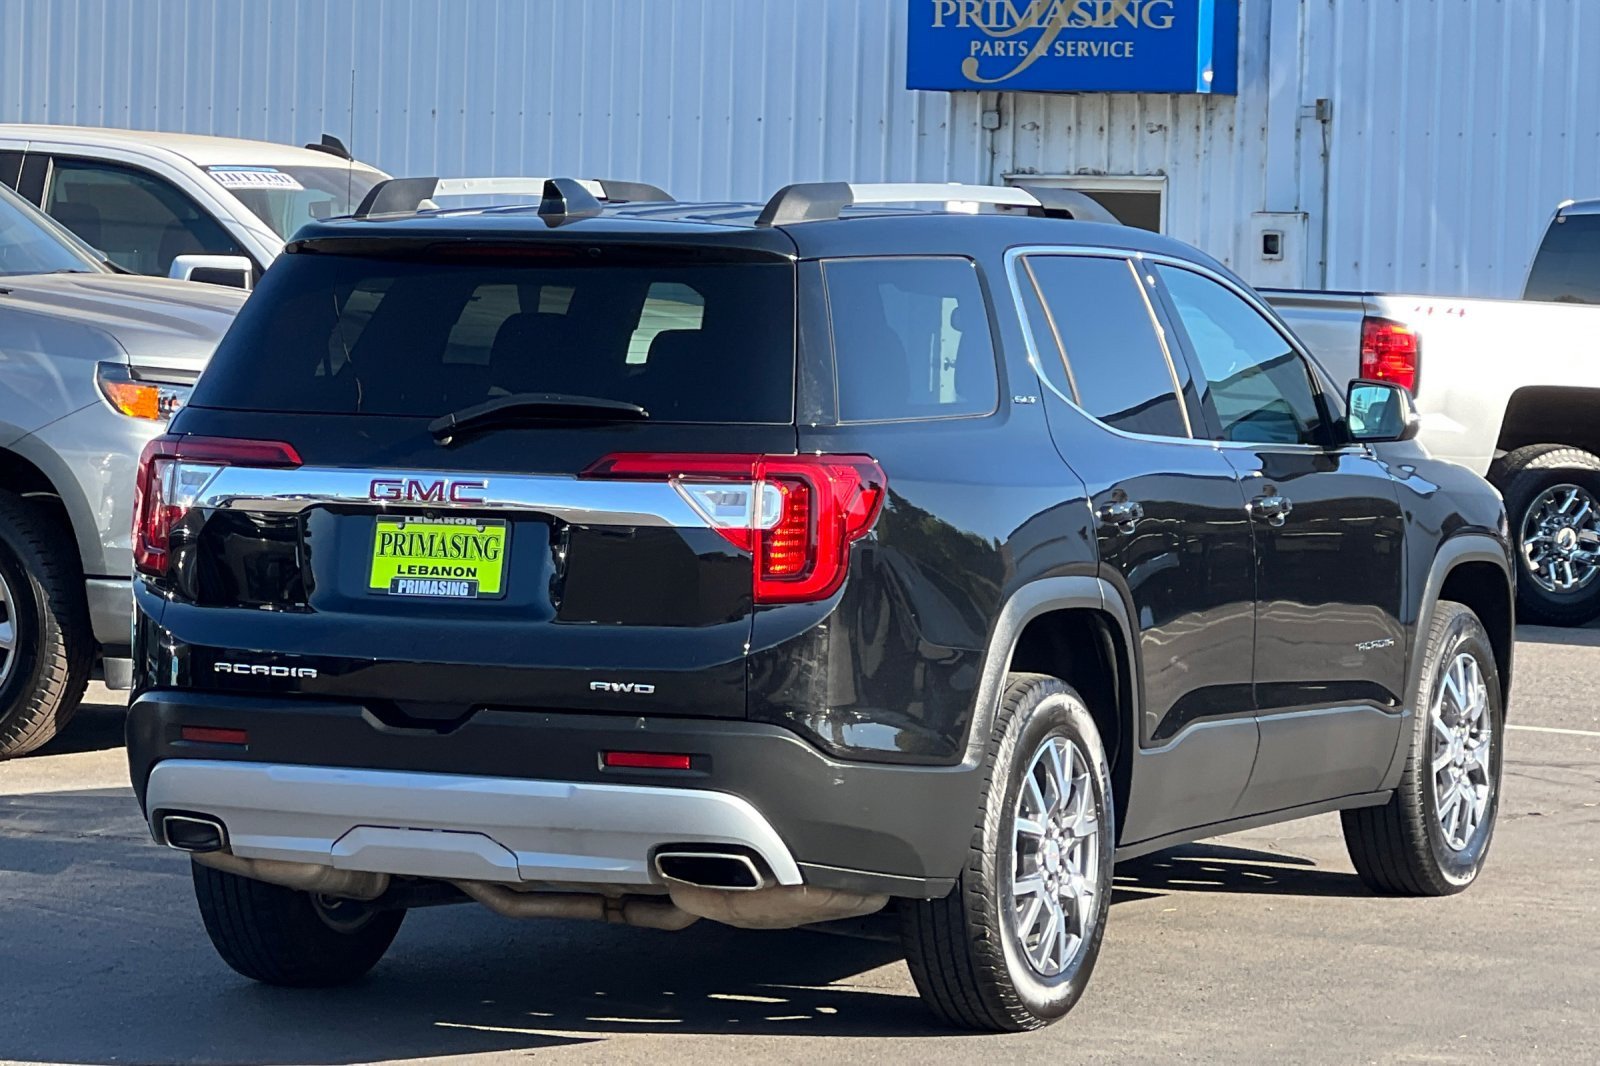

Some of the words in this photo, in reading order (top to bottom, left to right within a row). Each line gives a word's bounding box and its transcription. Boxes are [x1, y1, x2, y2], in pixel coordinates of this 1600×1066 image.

[931, 0, 1176, 29] PRIMASING
[970, 40, 1029, 57] PARTS
[1054, 40, 1135, 58] SERVICE
[369, 478, 489, 504] GMC
[377, 530, 501, 562] PRIMASING
[397, 564, 478, 578] LEBANON
[397, 579, 469, 596] PRIMASING
[213, 662, 318, 679] ACADIA
[589, 681, 656, 694] AWD
